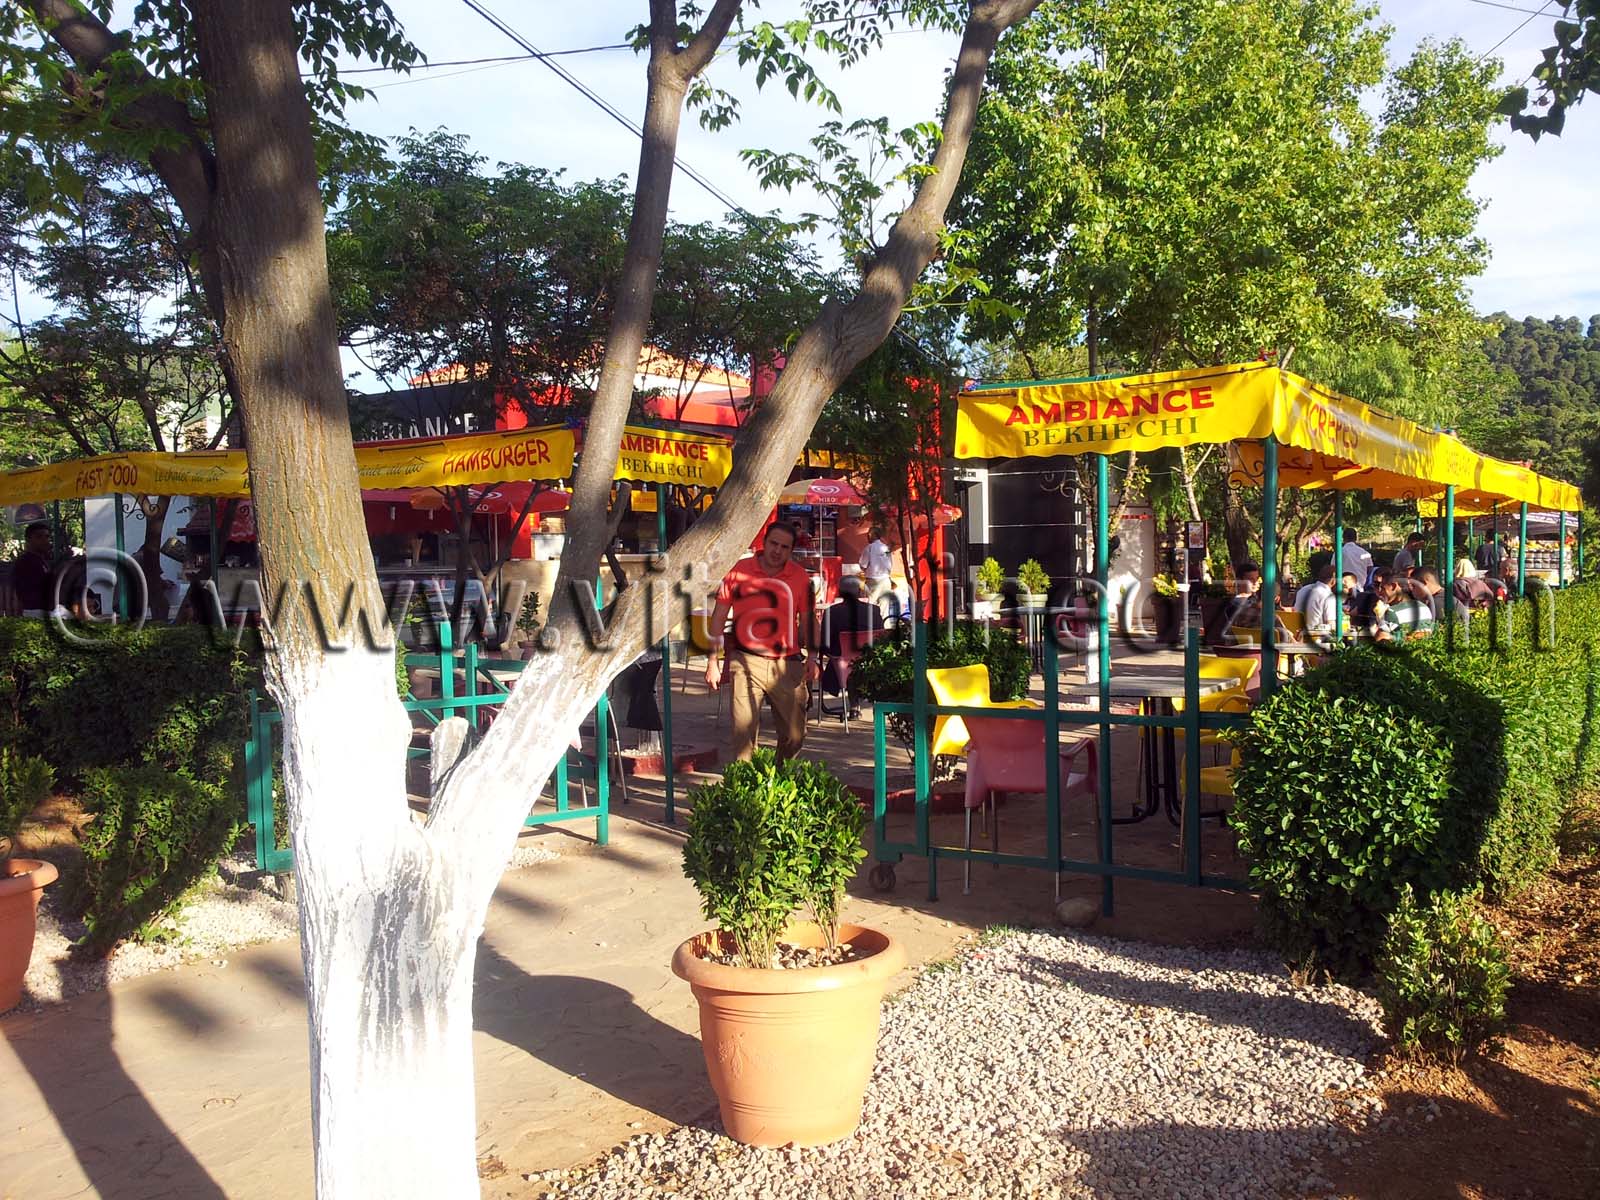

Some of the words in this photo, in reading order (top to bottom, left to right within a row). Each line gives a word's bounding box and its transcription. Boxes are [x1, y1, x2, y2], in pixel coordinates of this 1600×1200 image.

[1005, 386, 1215, 427] AMBIANCE
[1023, 416, 1200, 447] BEKHECHI
[442, 438, 550, 474] HAMBURGER
[622, 457, 703, 479] BEKHECHI
[75, 467, 104, 491] FAST
[109, 464, 138, 486] FOOD
